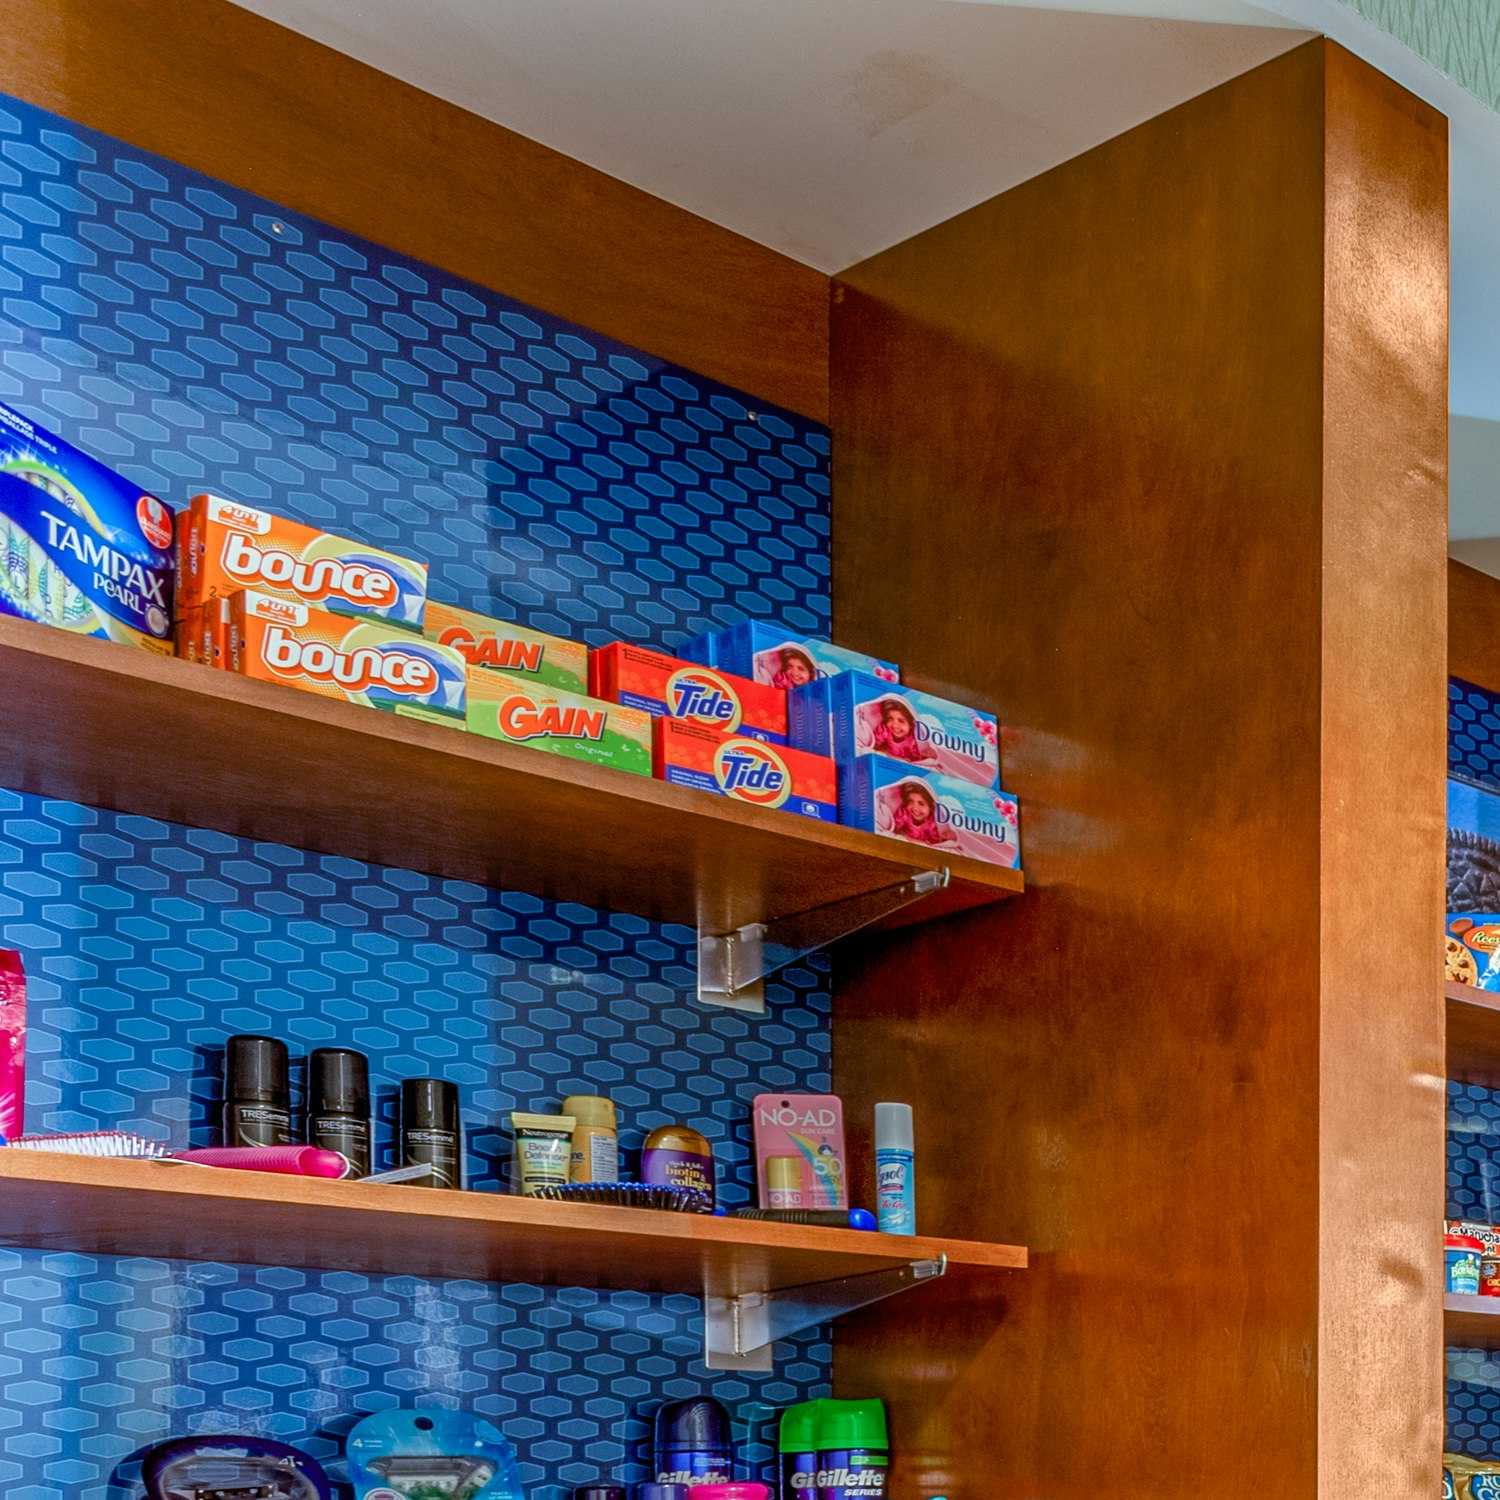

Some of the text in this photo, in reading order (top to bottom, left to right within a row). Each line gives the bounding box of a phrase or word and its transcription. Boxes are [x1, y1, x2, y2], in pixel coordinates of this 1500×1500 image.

[41, 510, 165, 607] TAMPAX
[225, 531, 392, 600] bounce
[265, 623, 432, 687] bounce
[673, 682, 734, 719] Tide
[498, 695, 606, 743] GAIN
[574, 742, 614, 759] Original
[915, 719, 986, 763] Downy
[721, 755, 784, 791] Tide
[934, 801, 1007, 843] Downy
[760, 1108, 836, 1127] NO-AD
[665, 1165, 700, 1177] biotin
[670, 1177, 713, 1191] collagen
[813, 1157, 843, 1175] 50
[816, 1468, 885, 1488] Gillette
[844, 1488, 883, 1497] SERIES
